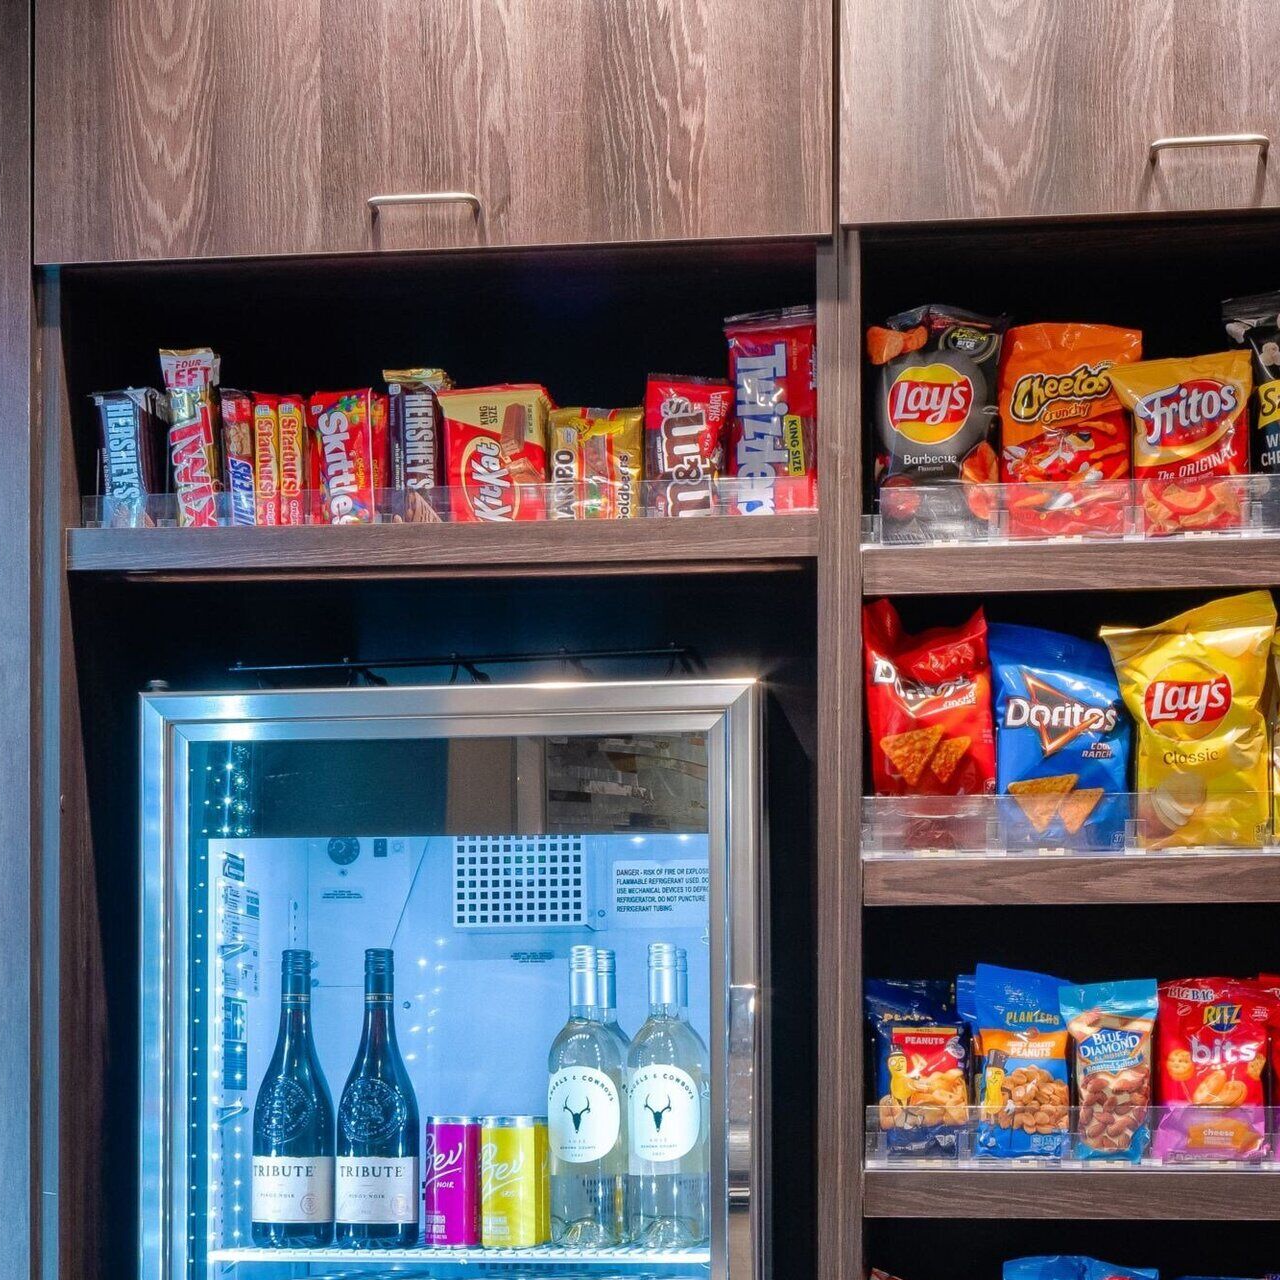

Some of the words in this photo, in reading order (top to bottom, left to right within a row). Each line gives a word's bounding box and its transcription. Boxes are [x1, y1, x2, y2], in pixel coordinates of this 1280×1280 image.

[175, 358, 202, 369] FOUR
[164, 367, 211, 388] LEFT
[894, 380, 969, 425] Lay's
[1011, 366, 1111, 421] Cheetos
[480, 405, 489, 426] KING
[489, 404, 498, 424] SIZE
[1041, 400, 1091, 425] Crunchy
[1136, 378, 1237, 445] Fritos
[404, 391, 436, 490] HERSHEY'S
[788, 419, 798, 445] KING
[106, 400, 141, 500] HERSHEY'S
[791, 450, 802, 472] SIZE
[903, 452, 957, 466] Barbecue
[170, 405, 218, 527] TWIX
[1157, 469, 1175, 481] The
[1178, 447, 1238, 477] ORIGINAL
[1149, 677, 1232, 726] Lay's
[1005, 698, 1116, 733] Doritos
[1163, 748, 1219, 766] Classic
[616, 868, 640, 876] DANGER
[1203, 1003, 1241, 1026] RITZ
[905, 1036, 946, 1046] PEANUTS
[1079, 1035, 1140, 1058] DIAMOND
[1092, 1031, 1122, 1045] BLUE
[1010, 1047, 1051, 1058] PEANUTS
[1190, 1036, 1258, 1064] bits
[1202, 1127, 1235, 1138] cheese
[253, 1164, 314, 1178] TRIBUTE
[340, 1165, 404, 1179] TRIBUTE
[436, 1180, 455, 1188] NOIR
